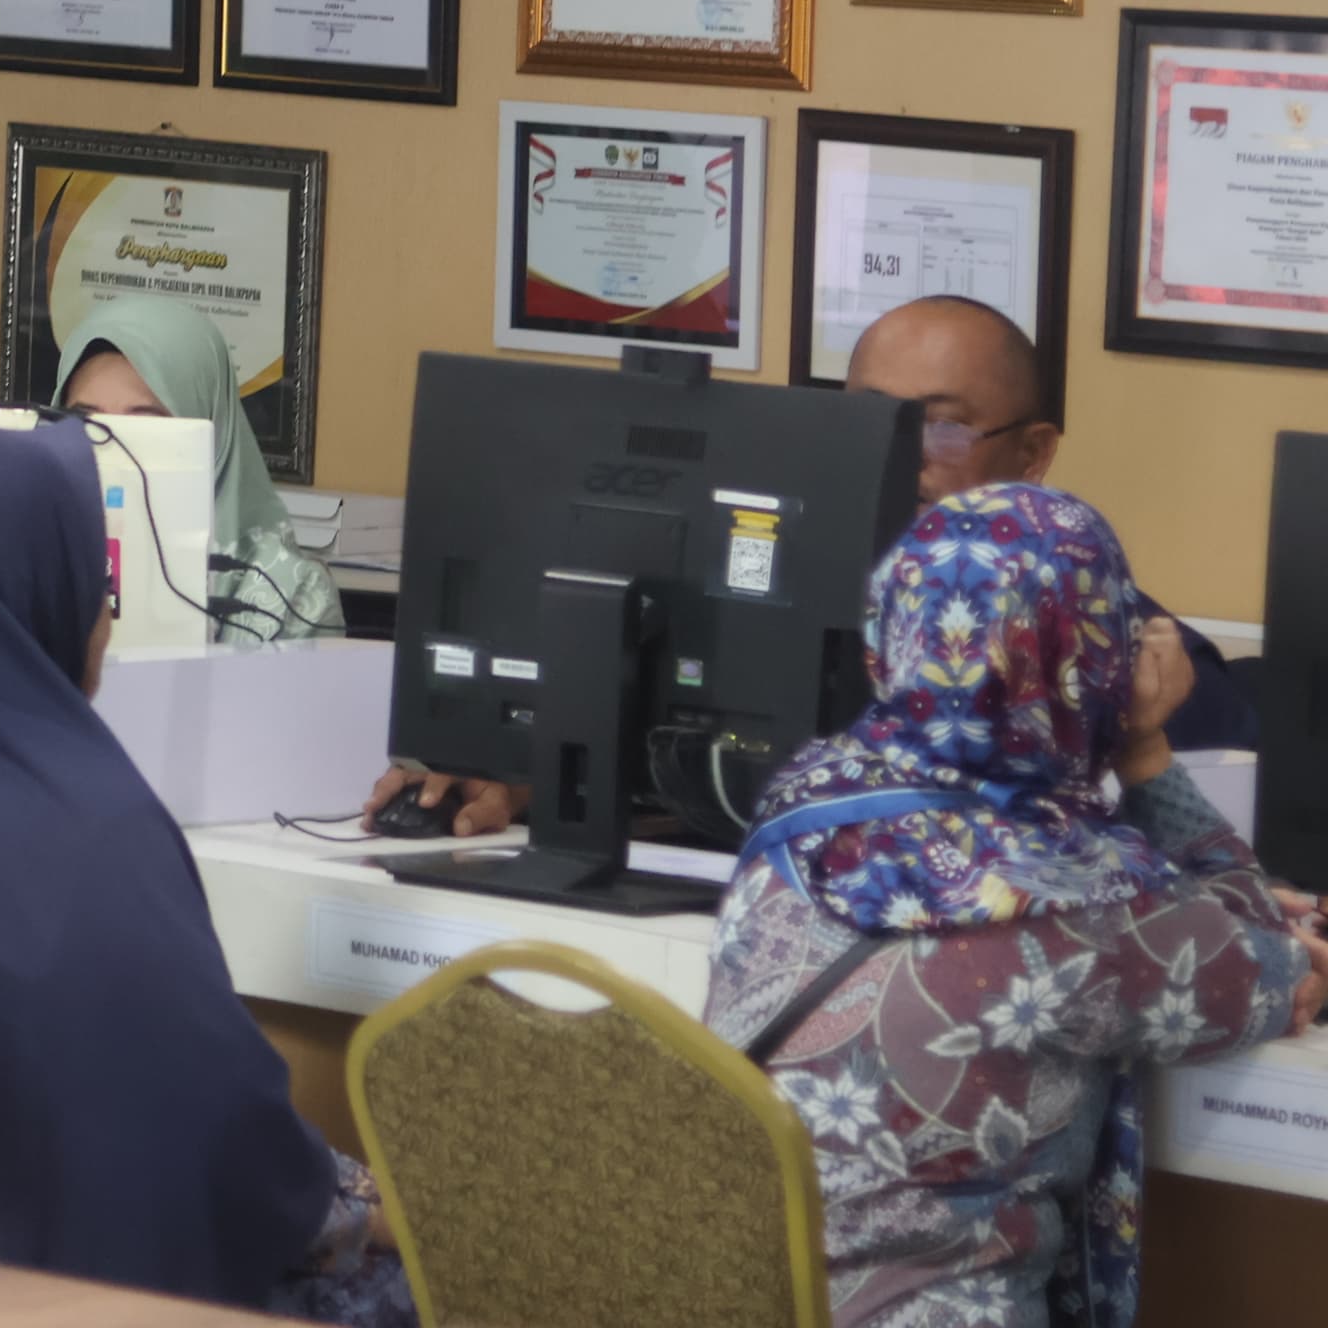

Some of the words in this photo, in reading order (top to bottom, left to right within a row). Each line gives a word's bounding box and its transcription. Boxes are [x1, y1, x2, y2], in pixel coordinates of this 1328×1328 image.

[1236, 151, 1275, 166] PIAGAM
[115, 234, 228, 272] Penghargaan
[350, 939, 420, 966] MUHAMAD
[1202, 1095, 1288, 1125] MUHAMMAD
